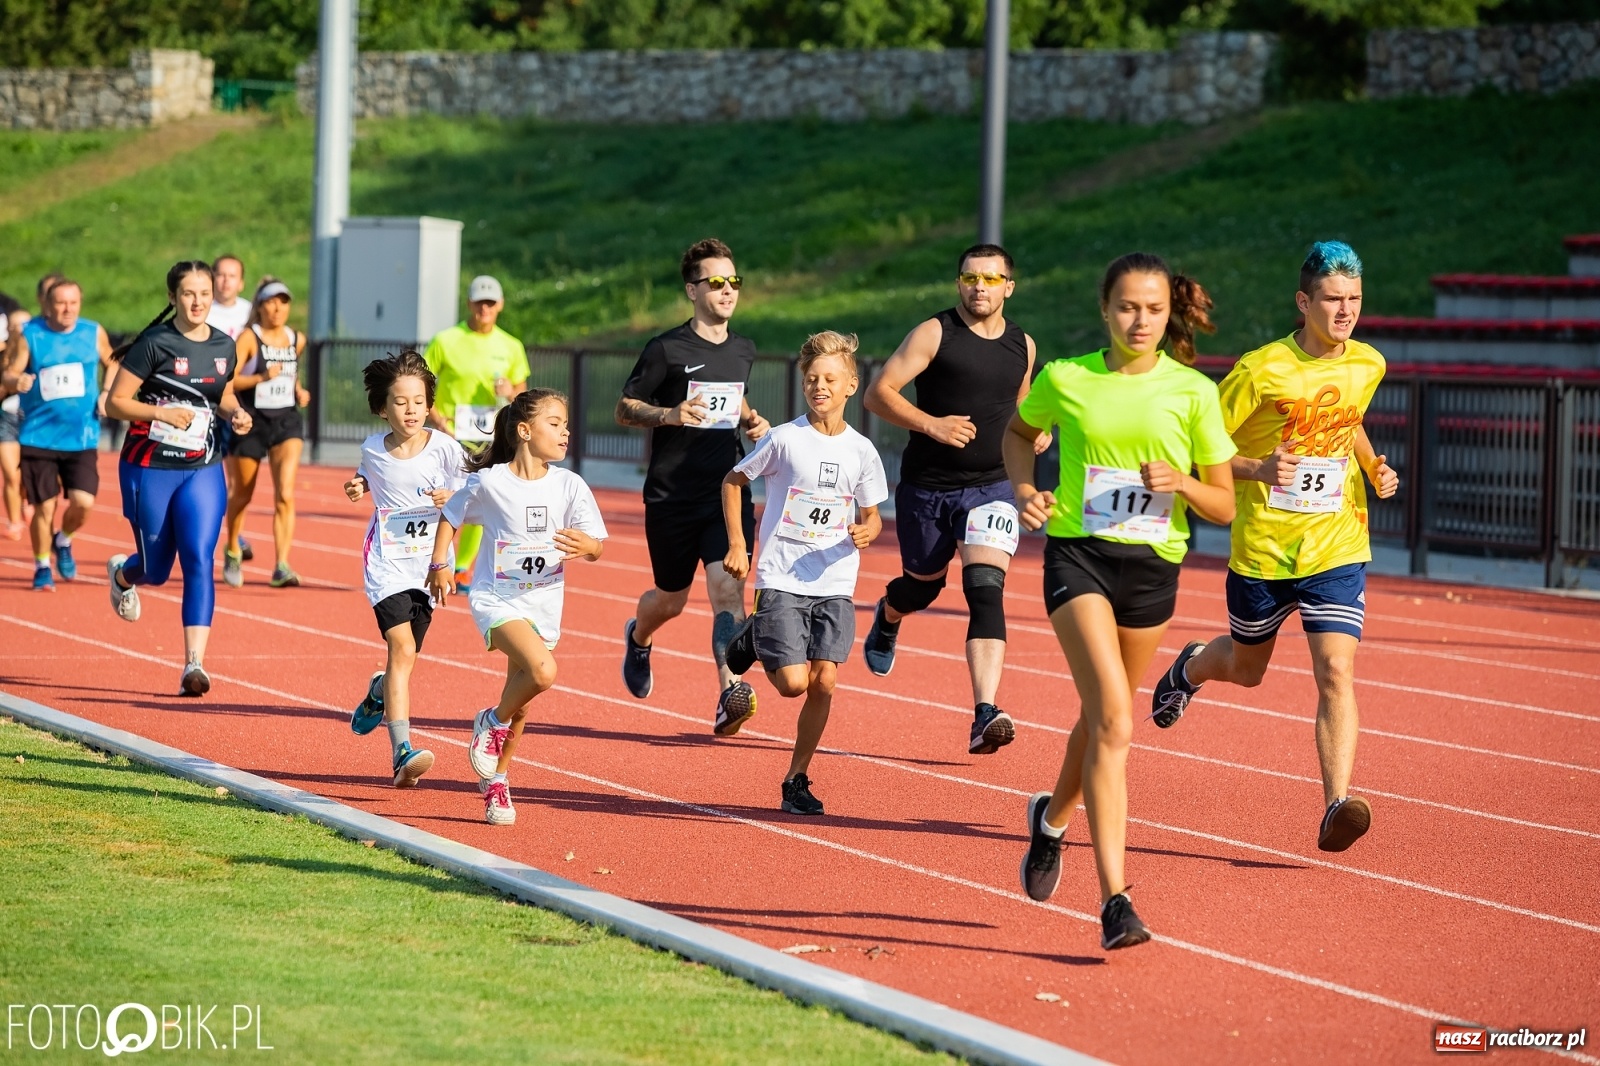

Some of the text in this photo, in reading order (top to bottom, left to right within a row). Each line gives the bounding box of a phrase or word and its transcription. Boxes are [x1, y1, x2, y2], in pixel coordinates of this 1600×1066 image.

[709, 396, 727, 411] 37
[1301, 473, 1325, 492] 35
[1111, 489, 1152, 515] 117
[809, 507, 831, 525] 48
[987, 514, 1013, 534] 100
[405, 520, 429, 539] 42
[521, 556, 546, 575] 49
